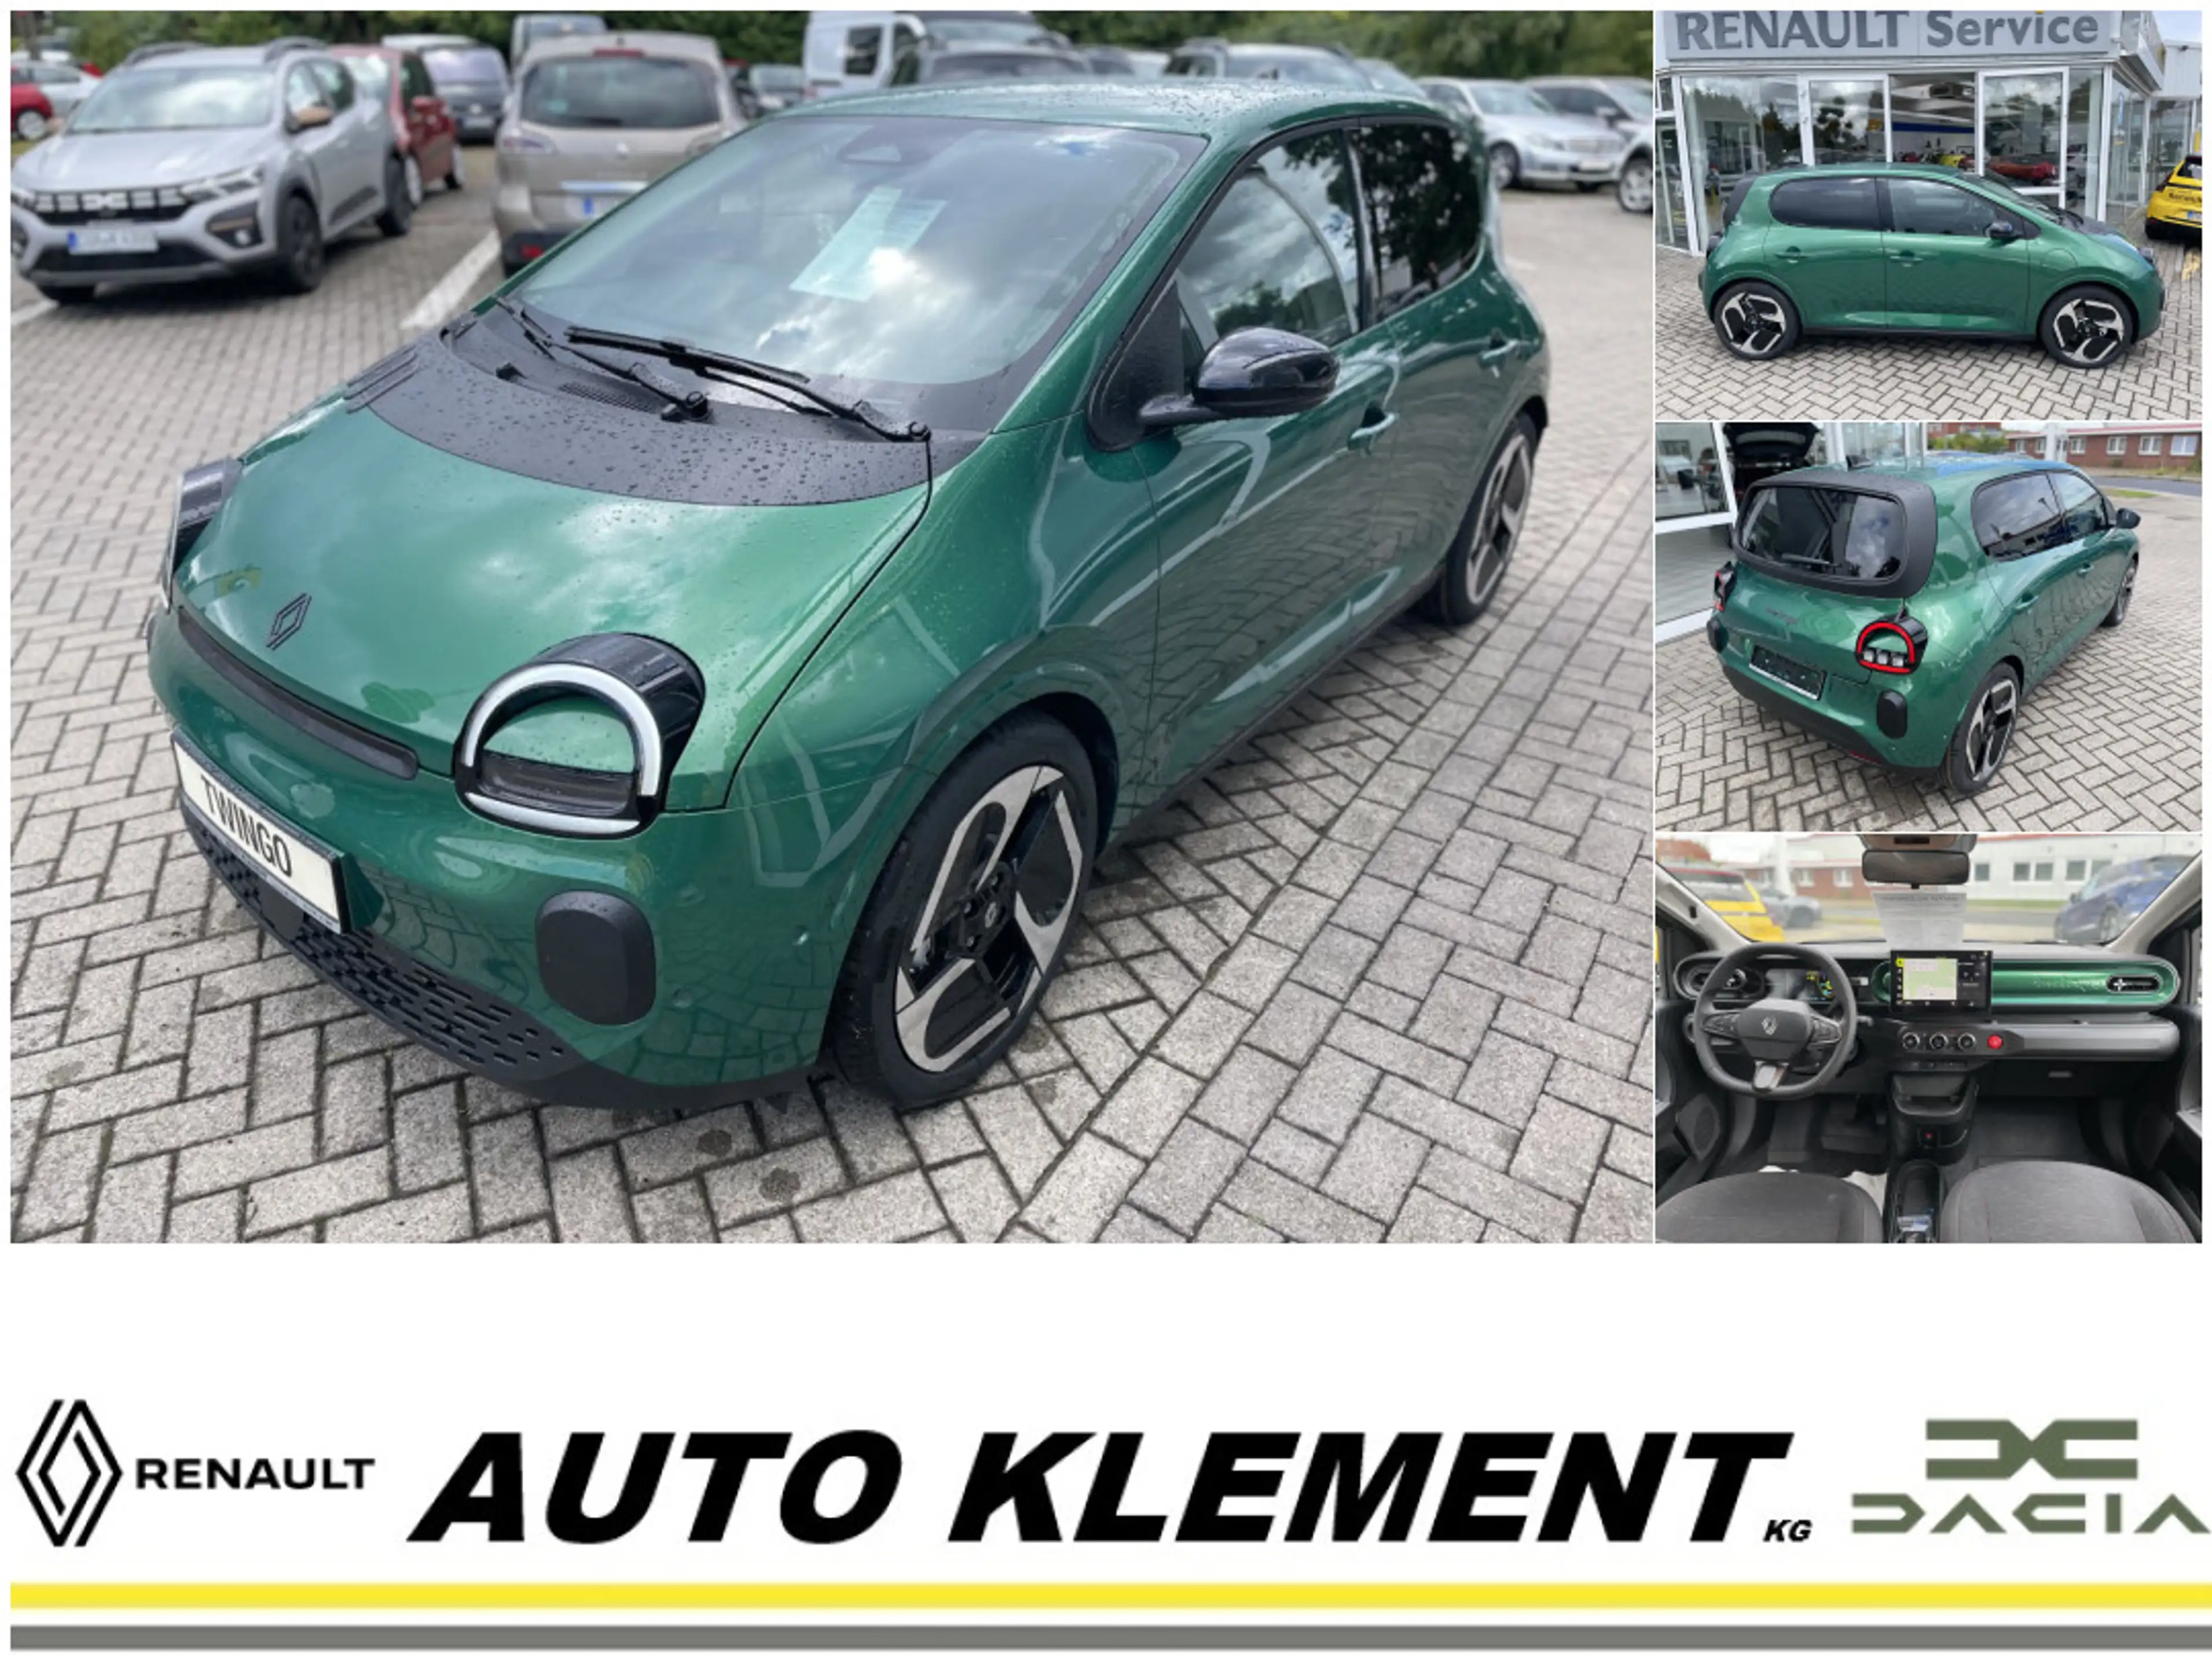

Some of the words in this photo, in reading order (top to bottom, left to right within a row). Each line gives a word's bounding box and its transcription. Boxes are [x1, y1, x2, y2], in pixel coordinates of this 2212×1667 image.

[1675, 10, 1909, 50] RENAULT
[1927, 10, 2099, 47] Service
[200, 773, 292, 878] TWINGO
